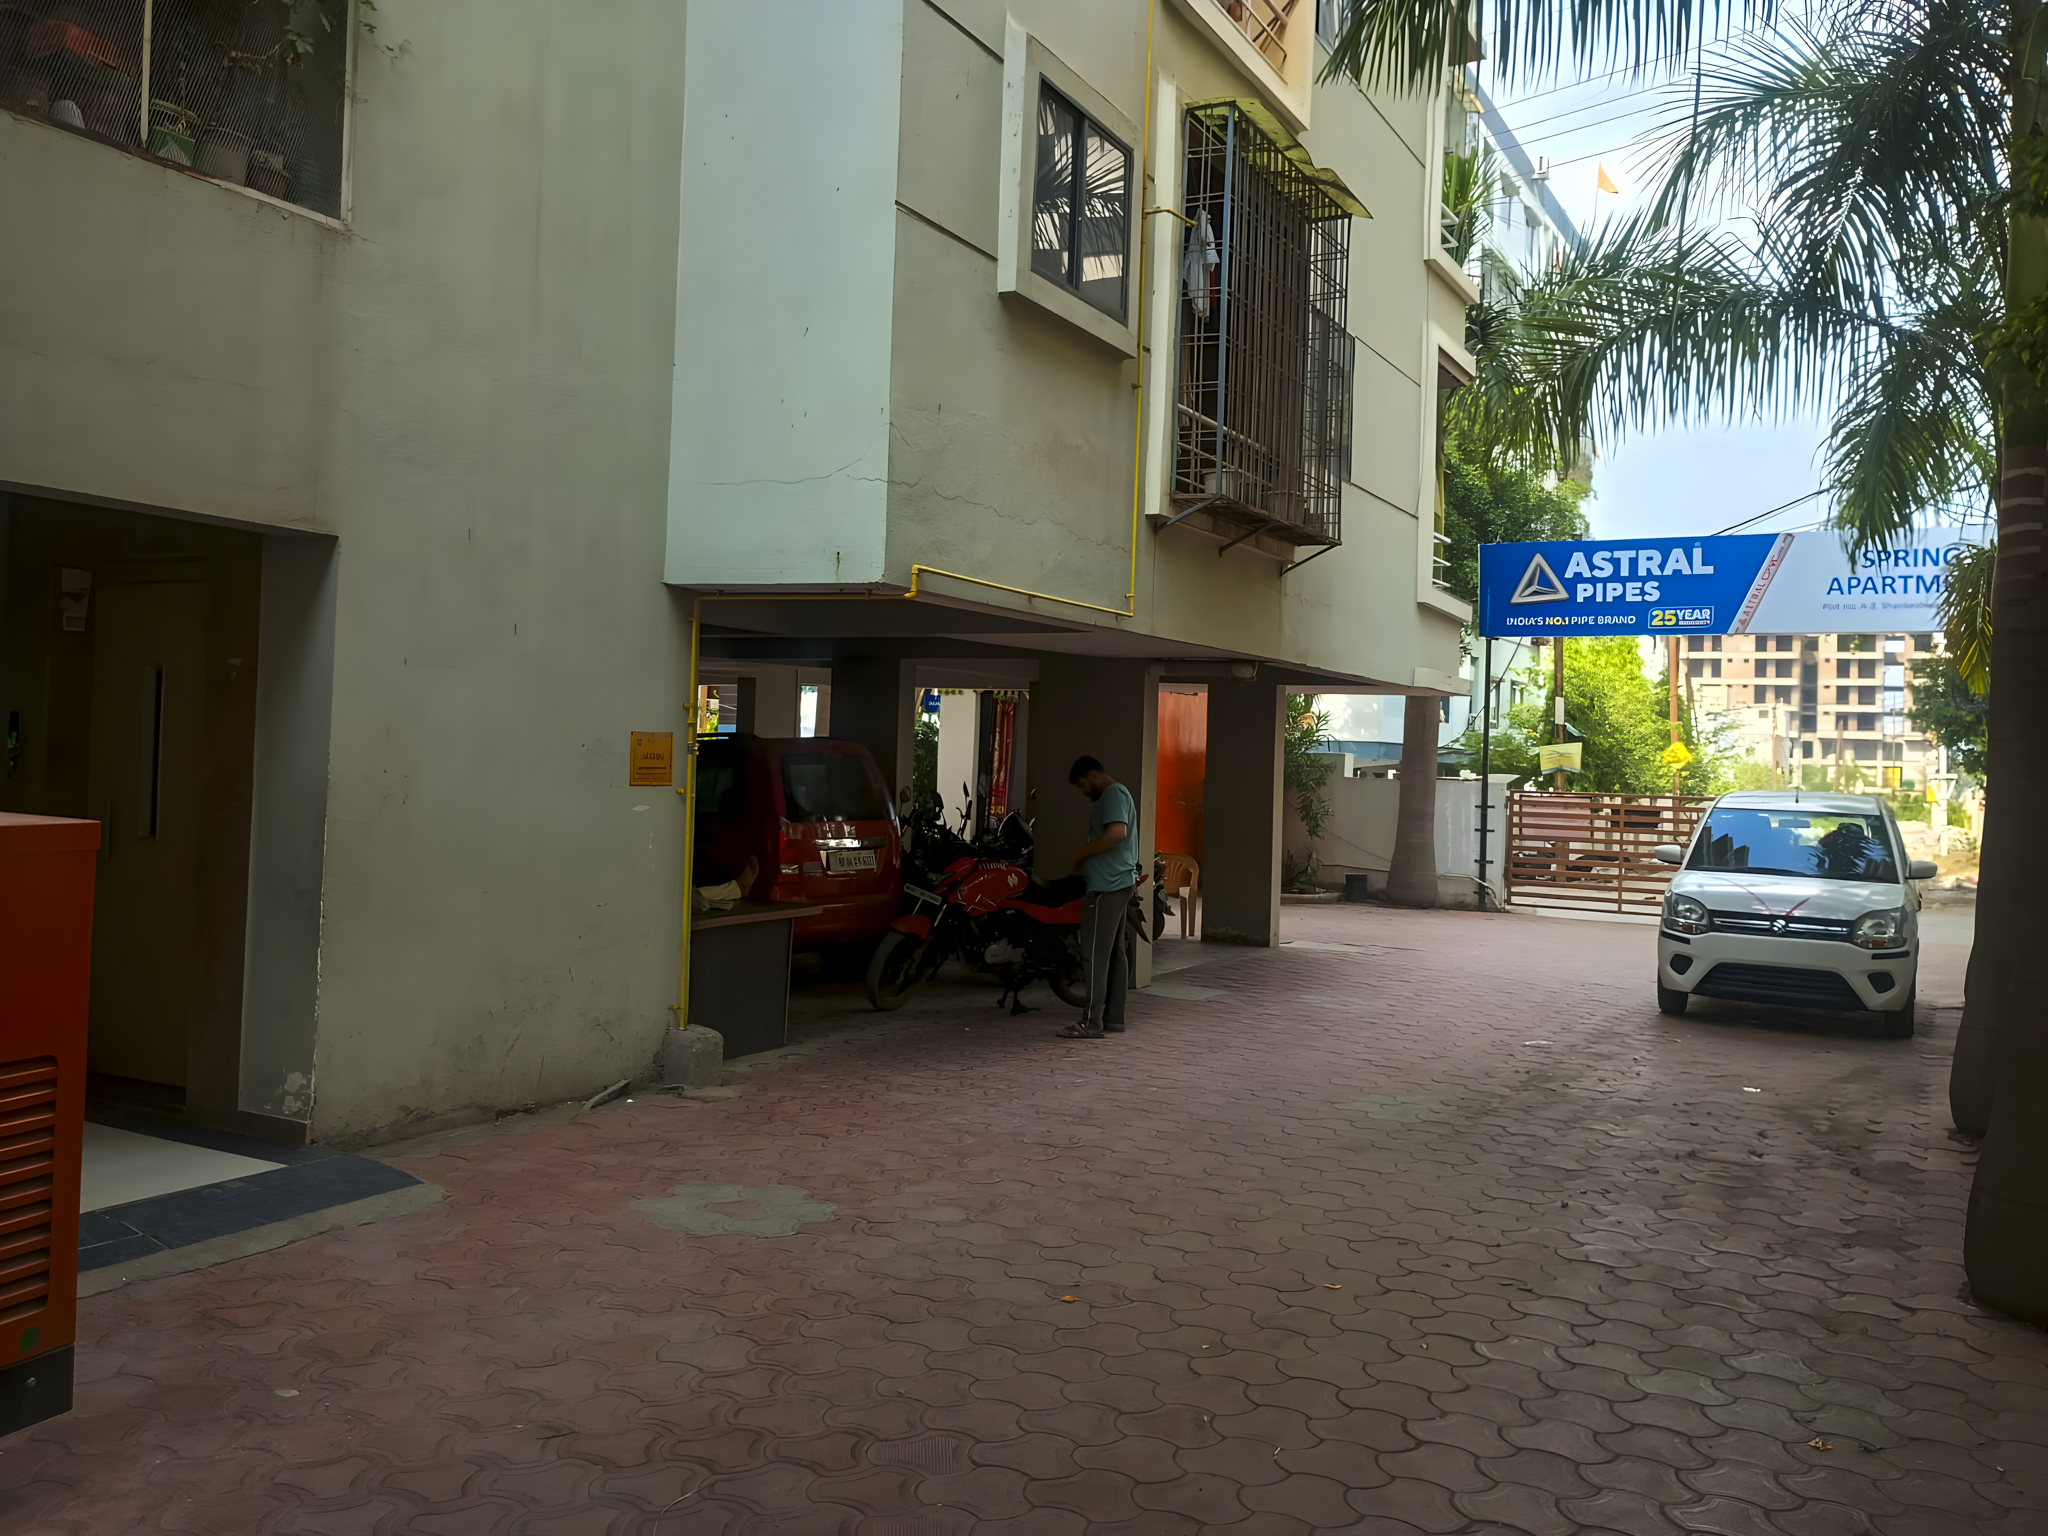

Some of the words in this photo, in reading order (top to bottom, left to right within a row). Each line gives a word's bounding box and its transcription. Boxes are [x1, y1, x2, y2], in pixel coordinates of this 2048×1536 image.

[1564, 547, 1714, 578] ASTRAL
[1576, 581, 1661, 603] PIPES
[1826, 575, 1940, 596] APARTM
[1506, 616, 1544, 626] INDIA'S
[1545, 616, 1569, 626] NO.1
[1571, 616, 1595, 625] PIPE
[1597, 615, 1636, 625] BRAND
[1651, 609, 1677, 626] 25
[1676, 609, 1711, 621] YEAR
